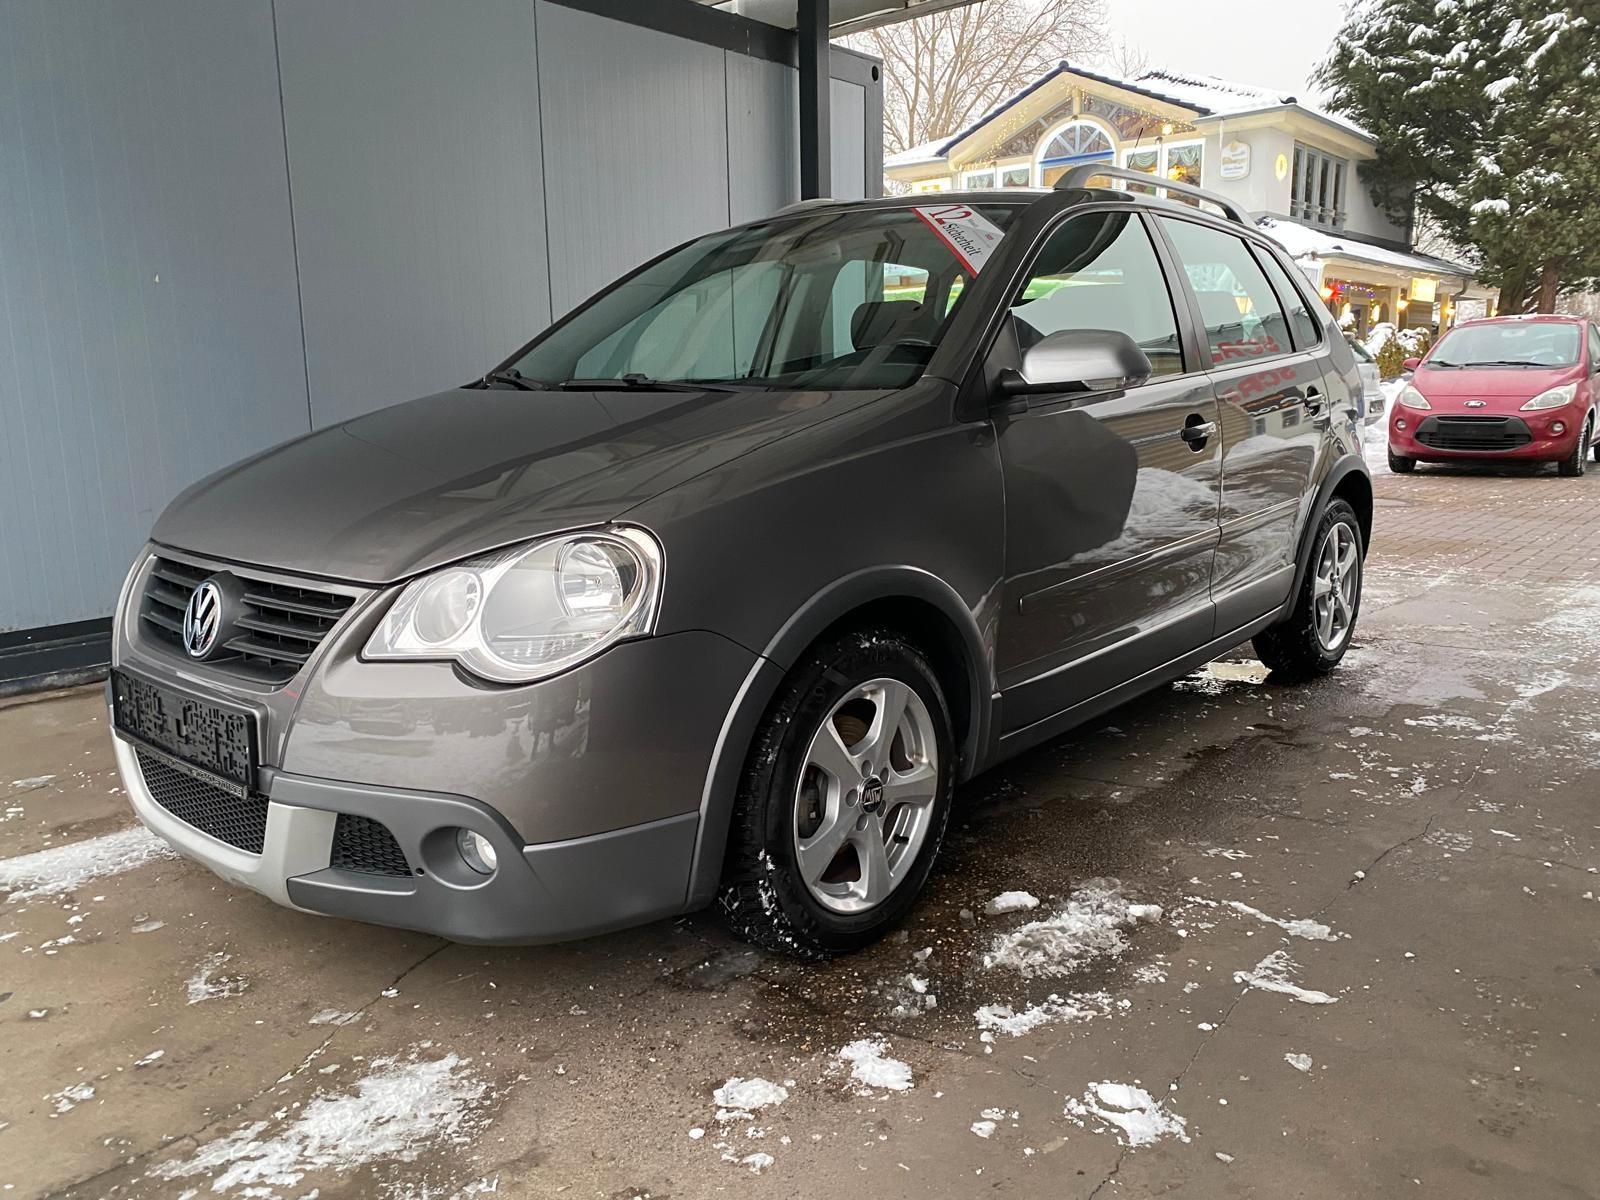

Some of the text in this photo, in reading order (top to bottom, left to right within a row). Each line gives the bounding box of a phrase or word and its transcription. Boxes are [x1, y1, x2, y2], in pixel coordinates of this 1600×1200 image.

[928, 204, 973, 226] 12
[942, 222, 982, 257] Sicherheit
[861, 787, 882, 806] MSW
